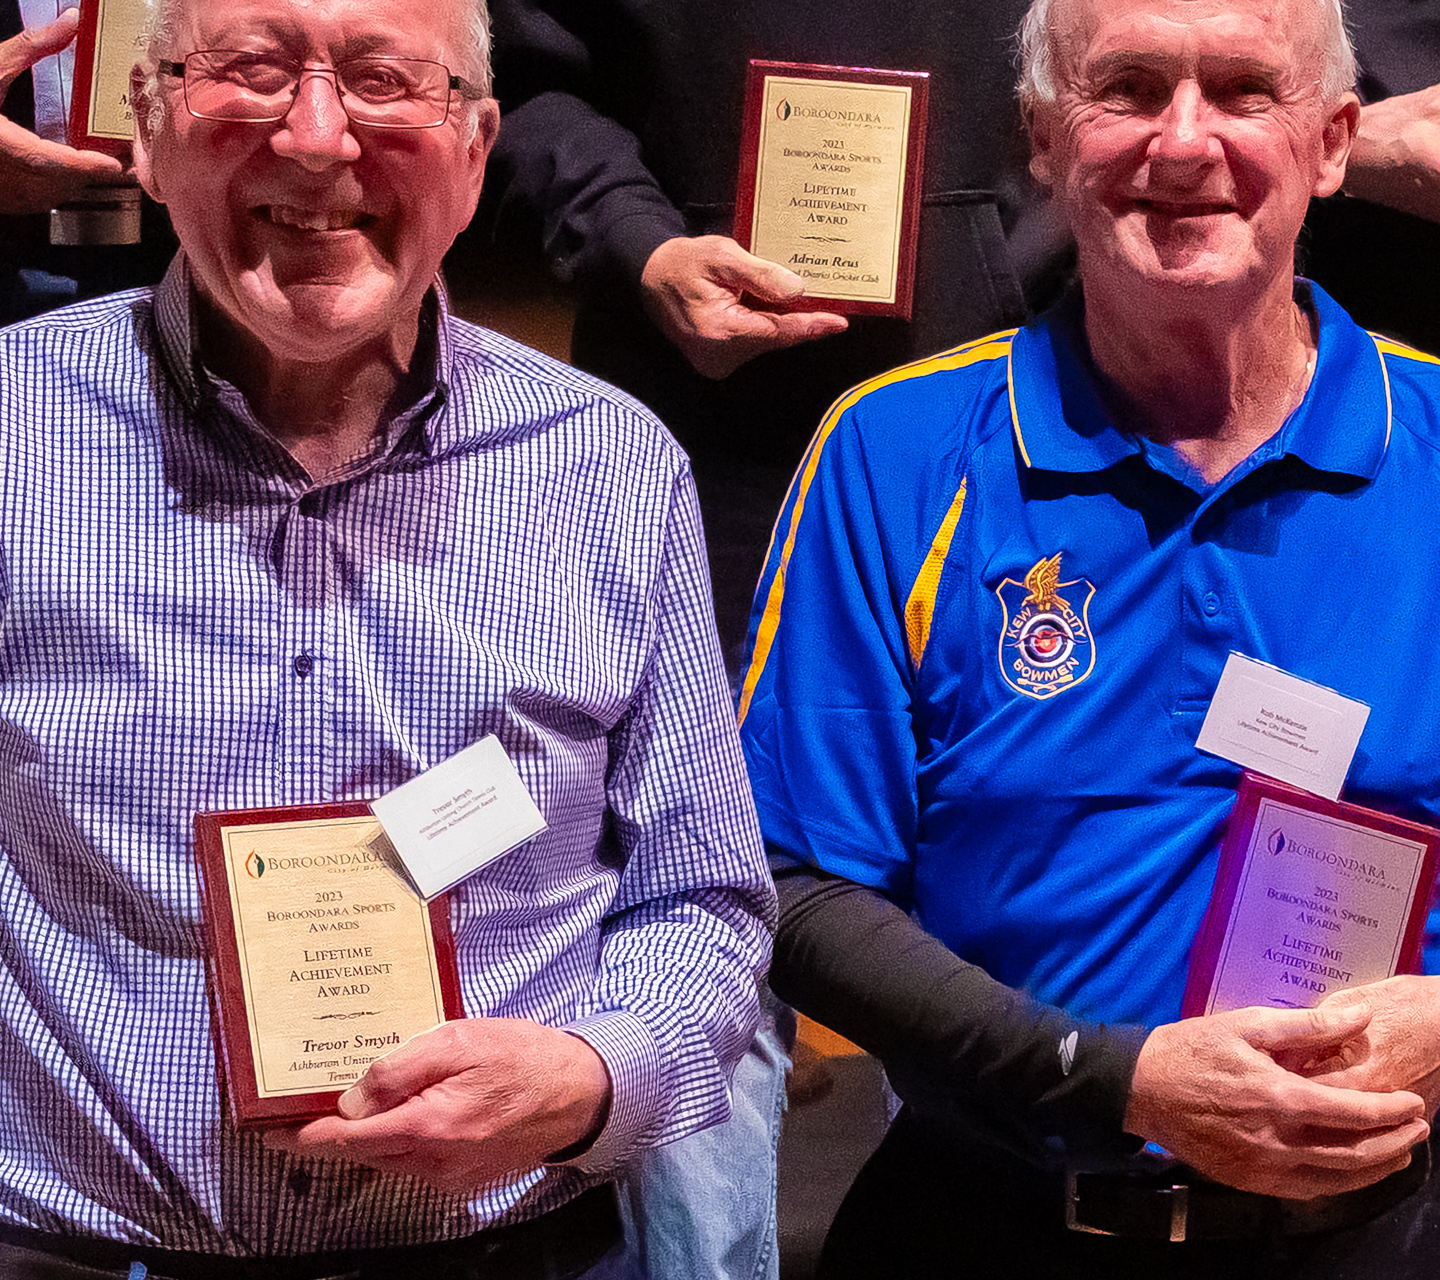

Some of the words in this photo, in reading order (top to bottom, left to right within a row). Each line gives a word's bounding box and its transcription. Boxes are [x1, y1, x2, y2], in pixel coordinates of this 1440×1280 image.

[793, 106, 881, 123] BOROONDARA
[822, 139, 844, 149] 2023
[783, 147, 845, 161] BOROONDARA
[812, 162, 851, 173] AWARDS
[803, 182, 856, 196] LIFETIME
[788, 196, 867, 212] ACHIEVEMENT
[806, 212, 848, 225] AWARD
[788, 253, 828, 265] Adrian
[831, 256, 859, 268] Reus
[1006, 606, 1031, 639] KEW
[1062, 607, 1087, 638] CITY
[1013, 656, 1080, 682] BOWMEN
[431, 799, 453, 815] Trevor
[452, 787, 473, 803] Smyth
[267, 849, 388, 870] BOROONDARA
[1286, 839, 1386, 879] BOROONDARA
[314, 890, 343, 903] 2023
[1313, 886, 1339, 902] 2023
[266, 906, 349, 922] BOROONDARA
[352, 901, 396, 914] SPORTS
[1266, 887, 1338, 916] BOROONDARA
[1340, 908, 1379, 928] SPORTS
[308, 920, 359, 933] AWARDS
[1295, 911, 1341, 932] AWARDS
[303, 945, 372, 962] LIFETIME
[1281, 934, 1343, 962] LIFETIME
[289, 962, 392, 982] ACHIEVEMENT
[1262, 947, 1353, 982] ACHIEVEMENT
[316, 982, 370, 998] AWARD
[1279, 971, 1327, 993] AWARD
[301, 1038, 349, 1053] Trevor
[352, 1031, 400, 1048] Smyth
[288, 1058, 339, 1071] Ashburton
[327, 1070, 358, 1081] Tennis
